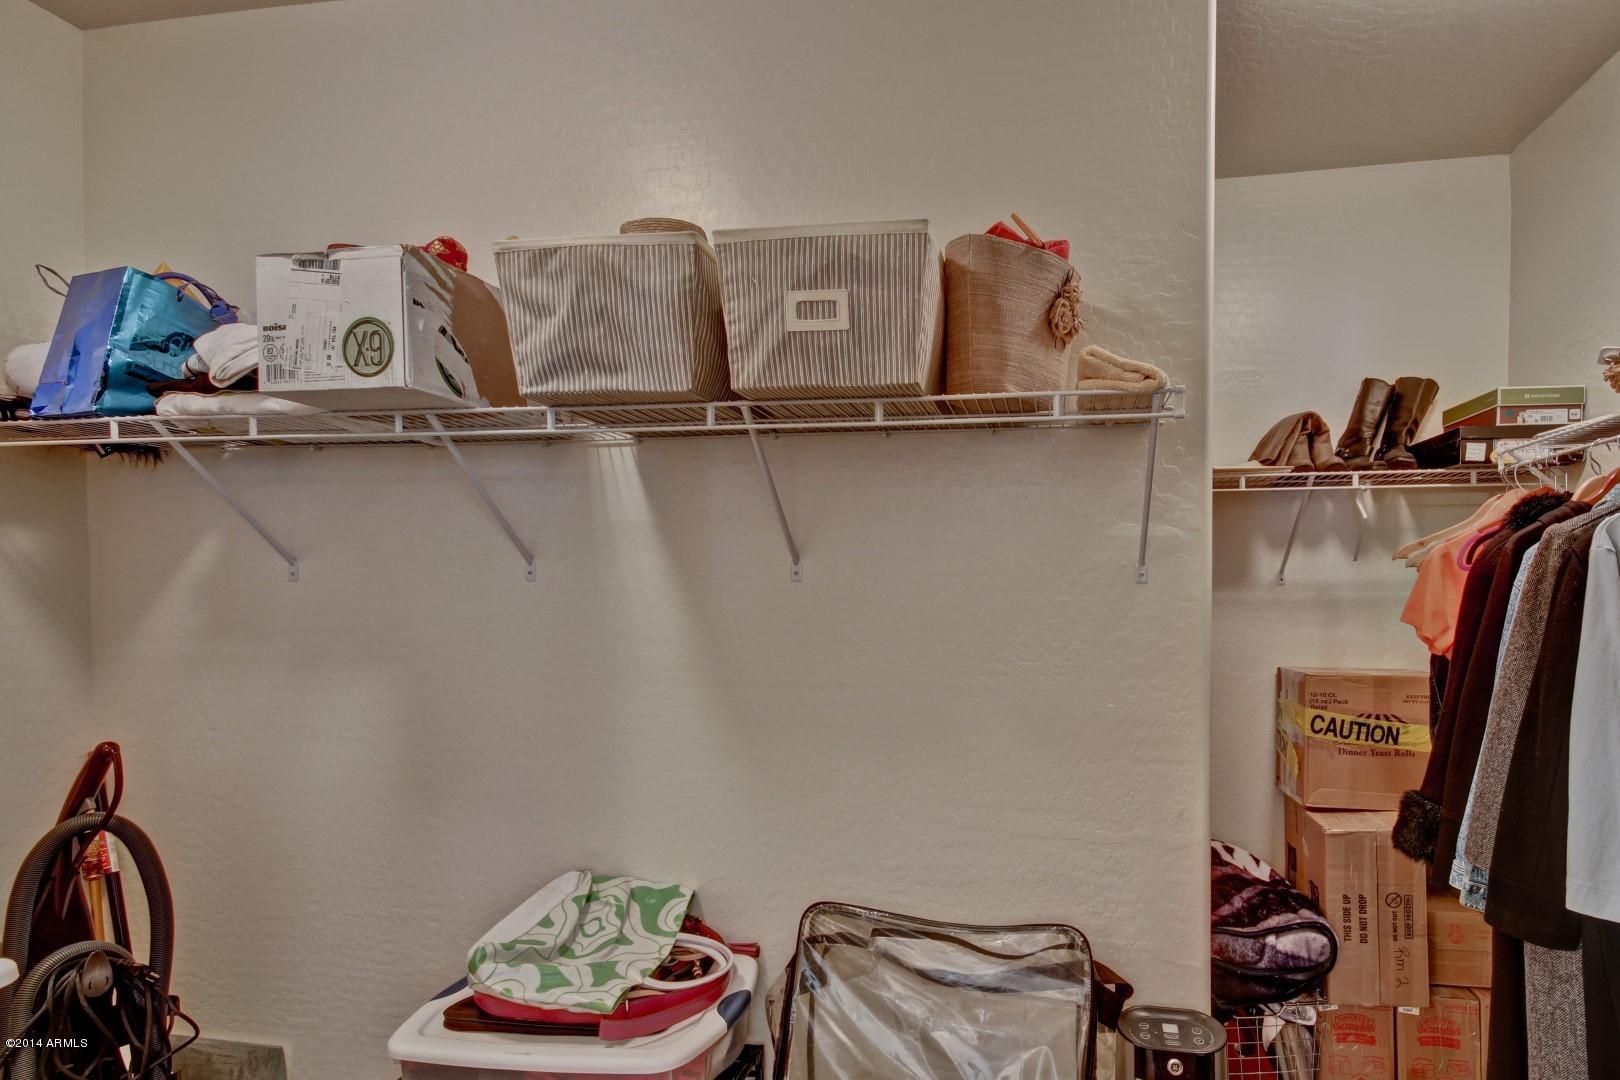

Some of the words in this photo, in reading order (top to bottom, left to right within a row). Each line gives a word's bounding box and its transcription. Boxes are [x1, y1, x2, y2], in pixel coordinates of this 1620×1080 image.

[1310, 714, 1401, 746] CAUTION
[1338, 747, 1367, 757] Dinner
[1370, 748, 1392, 757] Yeast
[1394, 749, 1416, 758] Rolls
[1342, 894, 1351, 904] UP
[1358, 894, 1367, 915] DROP
[1342, 906, 1351, 923] SIDE
[1359, 917, 1367, 932] NOT
[1343, 925, 1352, 942] THIS
[1359, 933, 1368, 944] DO
